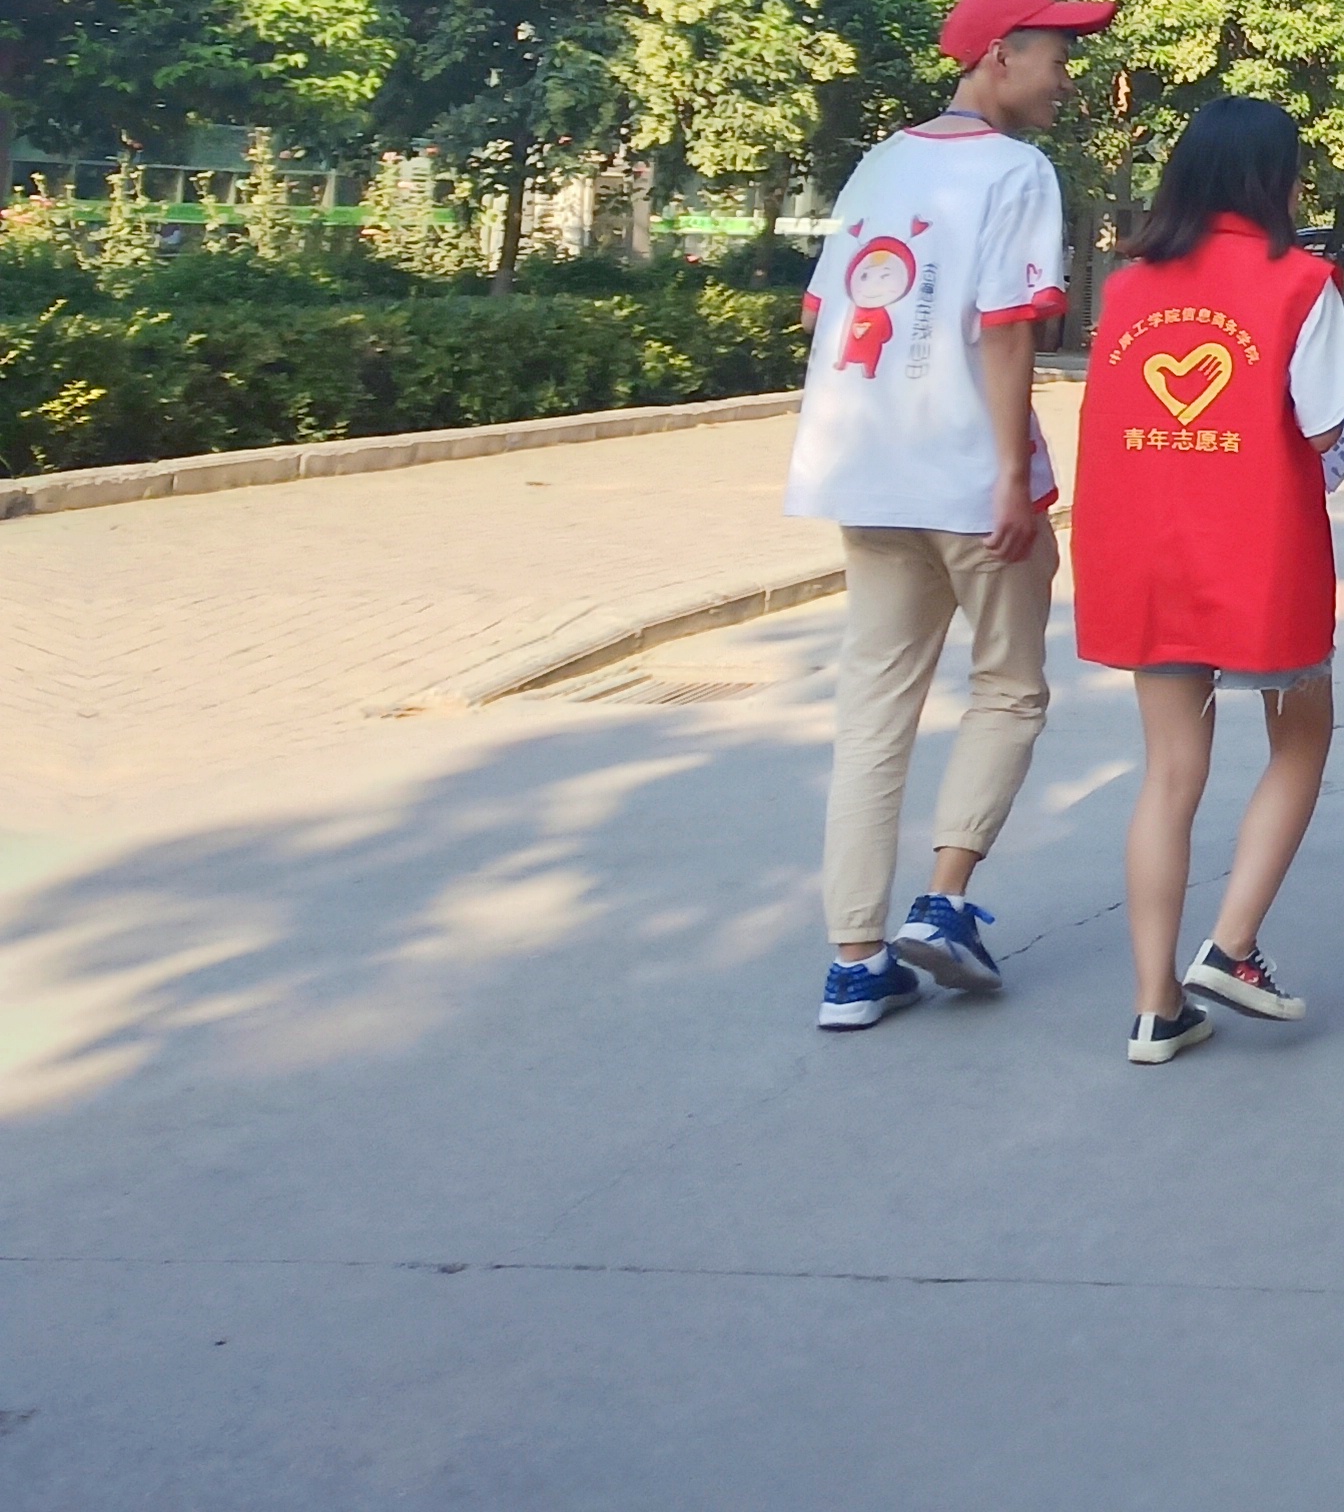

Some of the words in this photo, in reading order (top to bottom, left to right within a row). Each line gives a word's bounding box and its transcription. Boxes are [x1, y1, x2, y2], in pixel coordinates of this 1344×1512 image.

[1123, 428, 1242, 453] 青年志愿者
